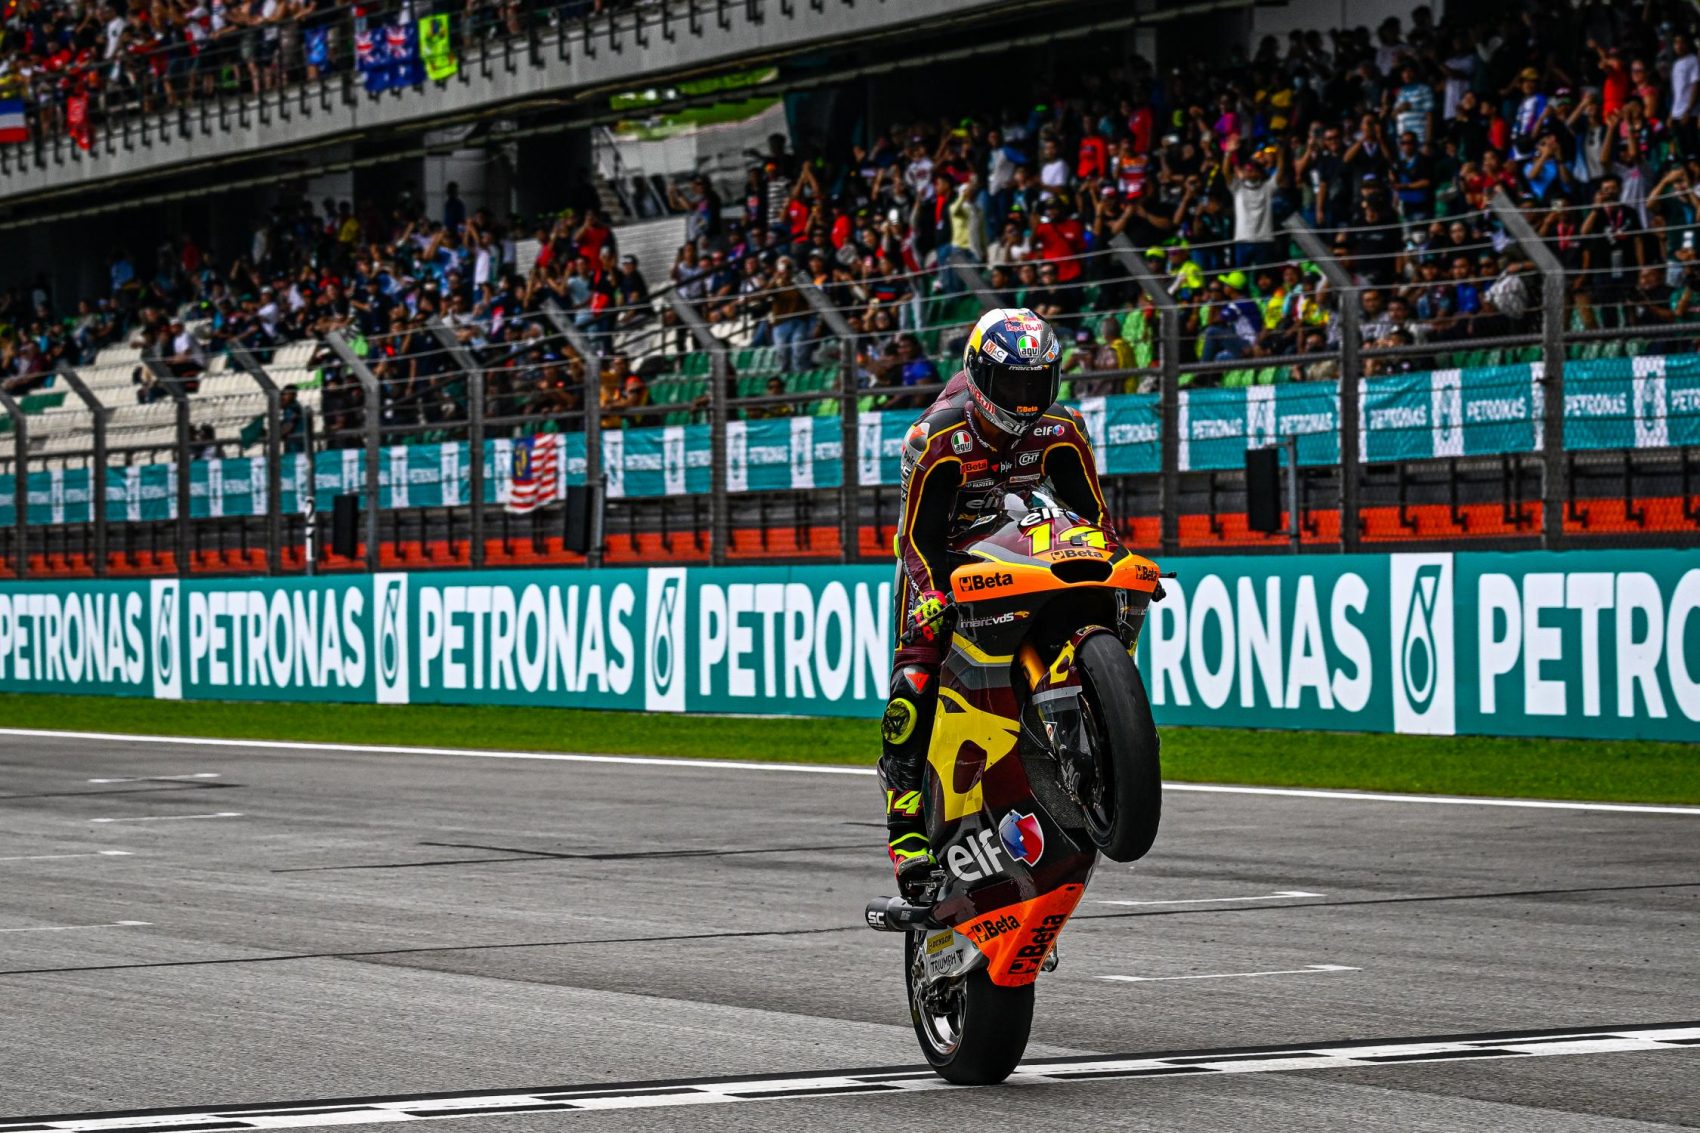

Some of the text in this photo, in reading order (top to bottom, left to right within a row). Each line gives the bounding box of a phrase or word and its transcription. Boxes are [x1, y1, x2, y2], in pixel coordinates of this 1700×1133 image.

[1005, 321, 1043, 331] Red Bull
[1021, 347, 1038, 358] agv
[1467, 397, 1525, 422] PETRONAS
[1033, 425, 1053, 436] elf
[1020, 508, 1067, 527] elf
[1020, 521, 1111, 556] 14
[1066, 549, 1103, 559] Beta
[972, 572, 1013, 590] Beta
[0, 591, 145, 684] PETRONAS
[189, 585, 367, 690] PETRONAS
[419, 582, 636, 695] PETRONAS
[700, 581, 891, 700] PETRON
[1149, 572, 1373, 712] RONAS
[886, 789, 922, 815] 14
[947, 828, 1004, 882] elf
[868, 911, 885, 925] SC
[982, 914, 1021, 938] Beta
[1016, 913, 1069, 958] Beta
